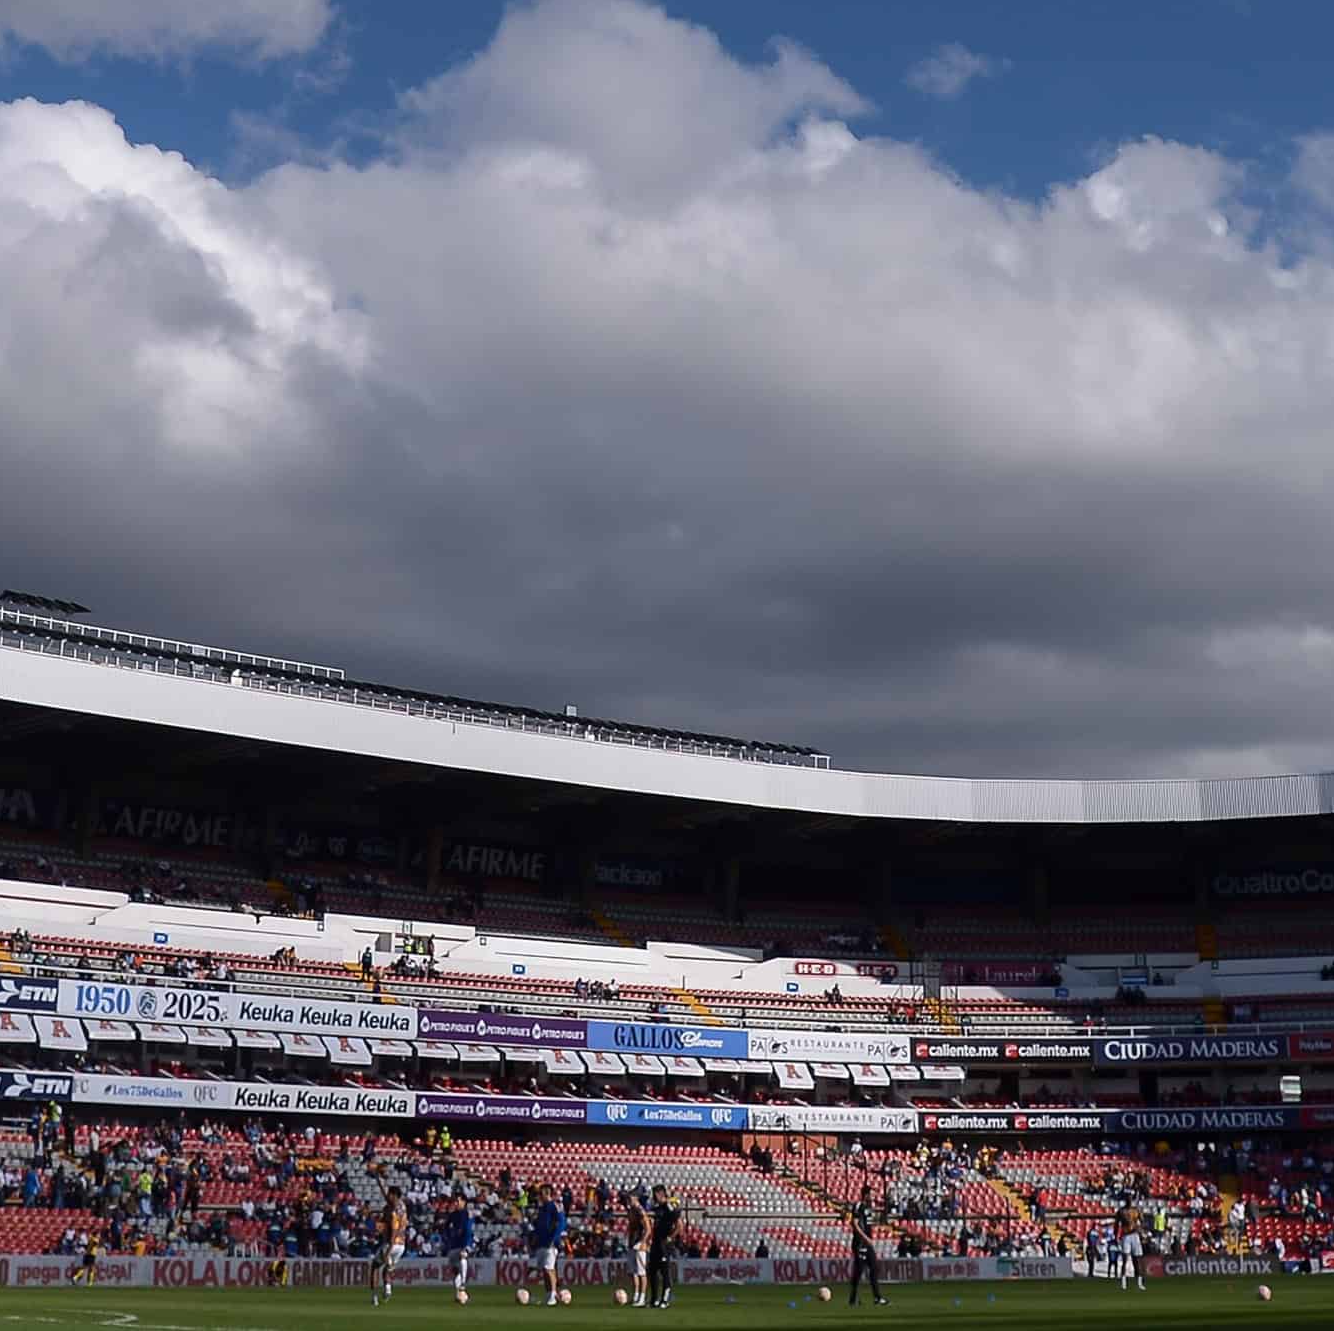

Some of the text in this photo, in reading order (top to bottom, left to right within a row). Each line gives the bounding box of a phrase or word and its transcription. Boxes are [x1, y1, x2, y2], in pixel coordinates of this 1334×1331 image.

[18, 985, 57, 1003] ETN
[75, 984, 131, 1015] 1950
[163, 991, 220, 1022] 2025
[239, 1001, 410, 1032] Keuka Keuka Keuka
[614, 1026, 685, 1051] GALLOS
[928, 1043, 998, 1058] caliente.mx
[1018, 1043, 1090, 1058] caliente.mx
[1104, 1039, 1279, 1060] CIUDAD MADERAS
[31, 1079, 70, 1095] ETN
[193, 1085, 218, 1103] QFC
[235, 1087, 408, 1114] Keuka Keuka Keuka
[937, 1116, 1008, 1130] caliente.mx
[1028, 1116, 1100, 1130] caliente.mx
[1122, 1111, 1284, 1130] CIUDAD MADERAS
[153, 1260, 219, 1285] KOLA
[772, 1259, 817, 1282] KOLA
